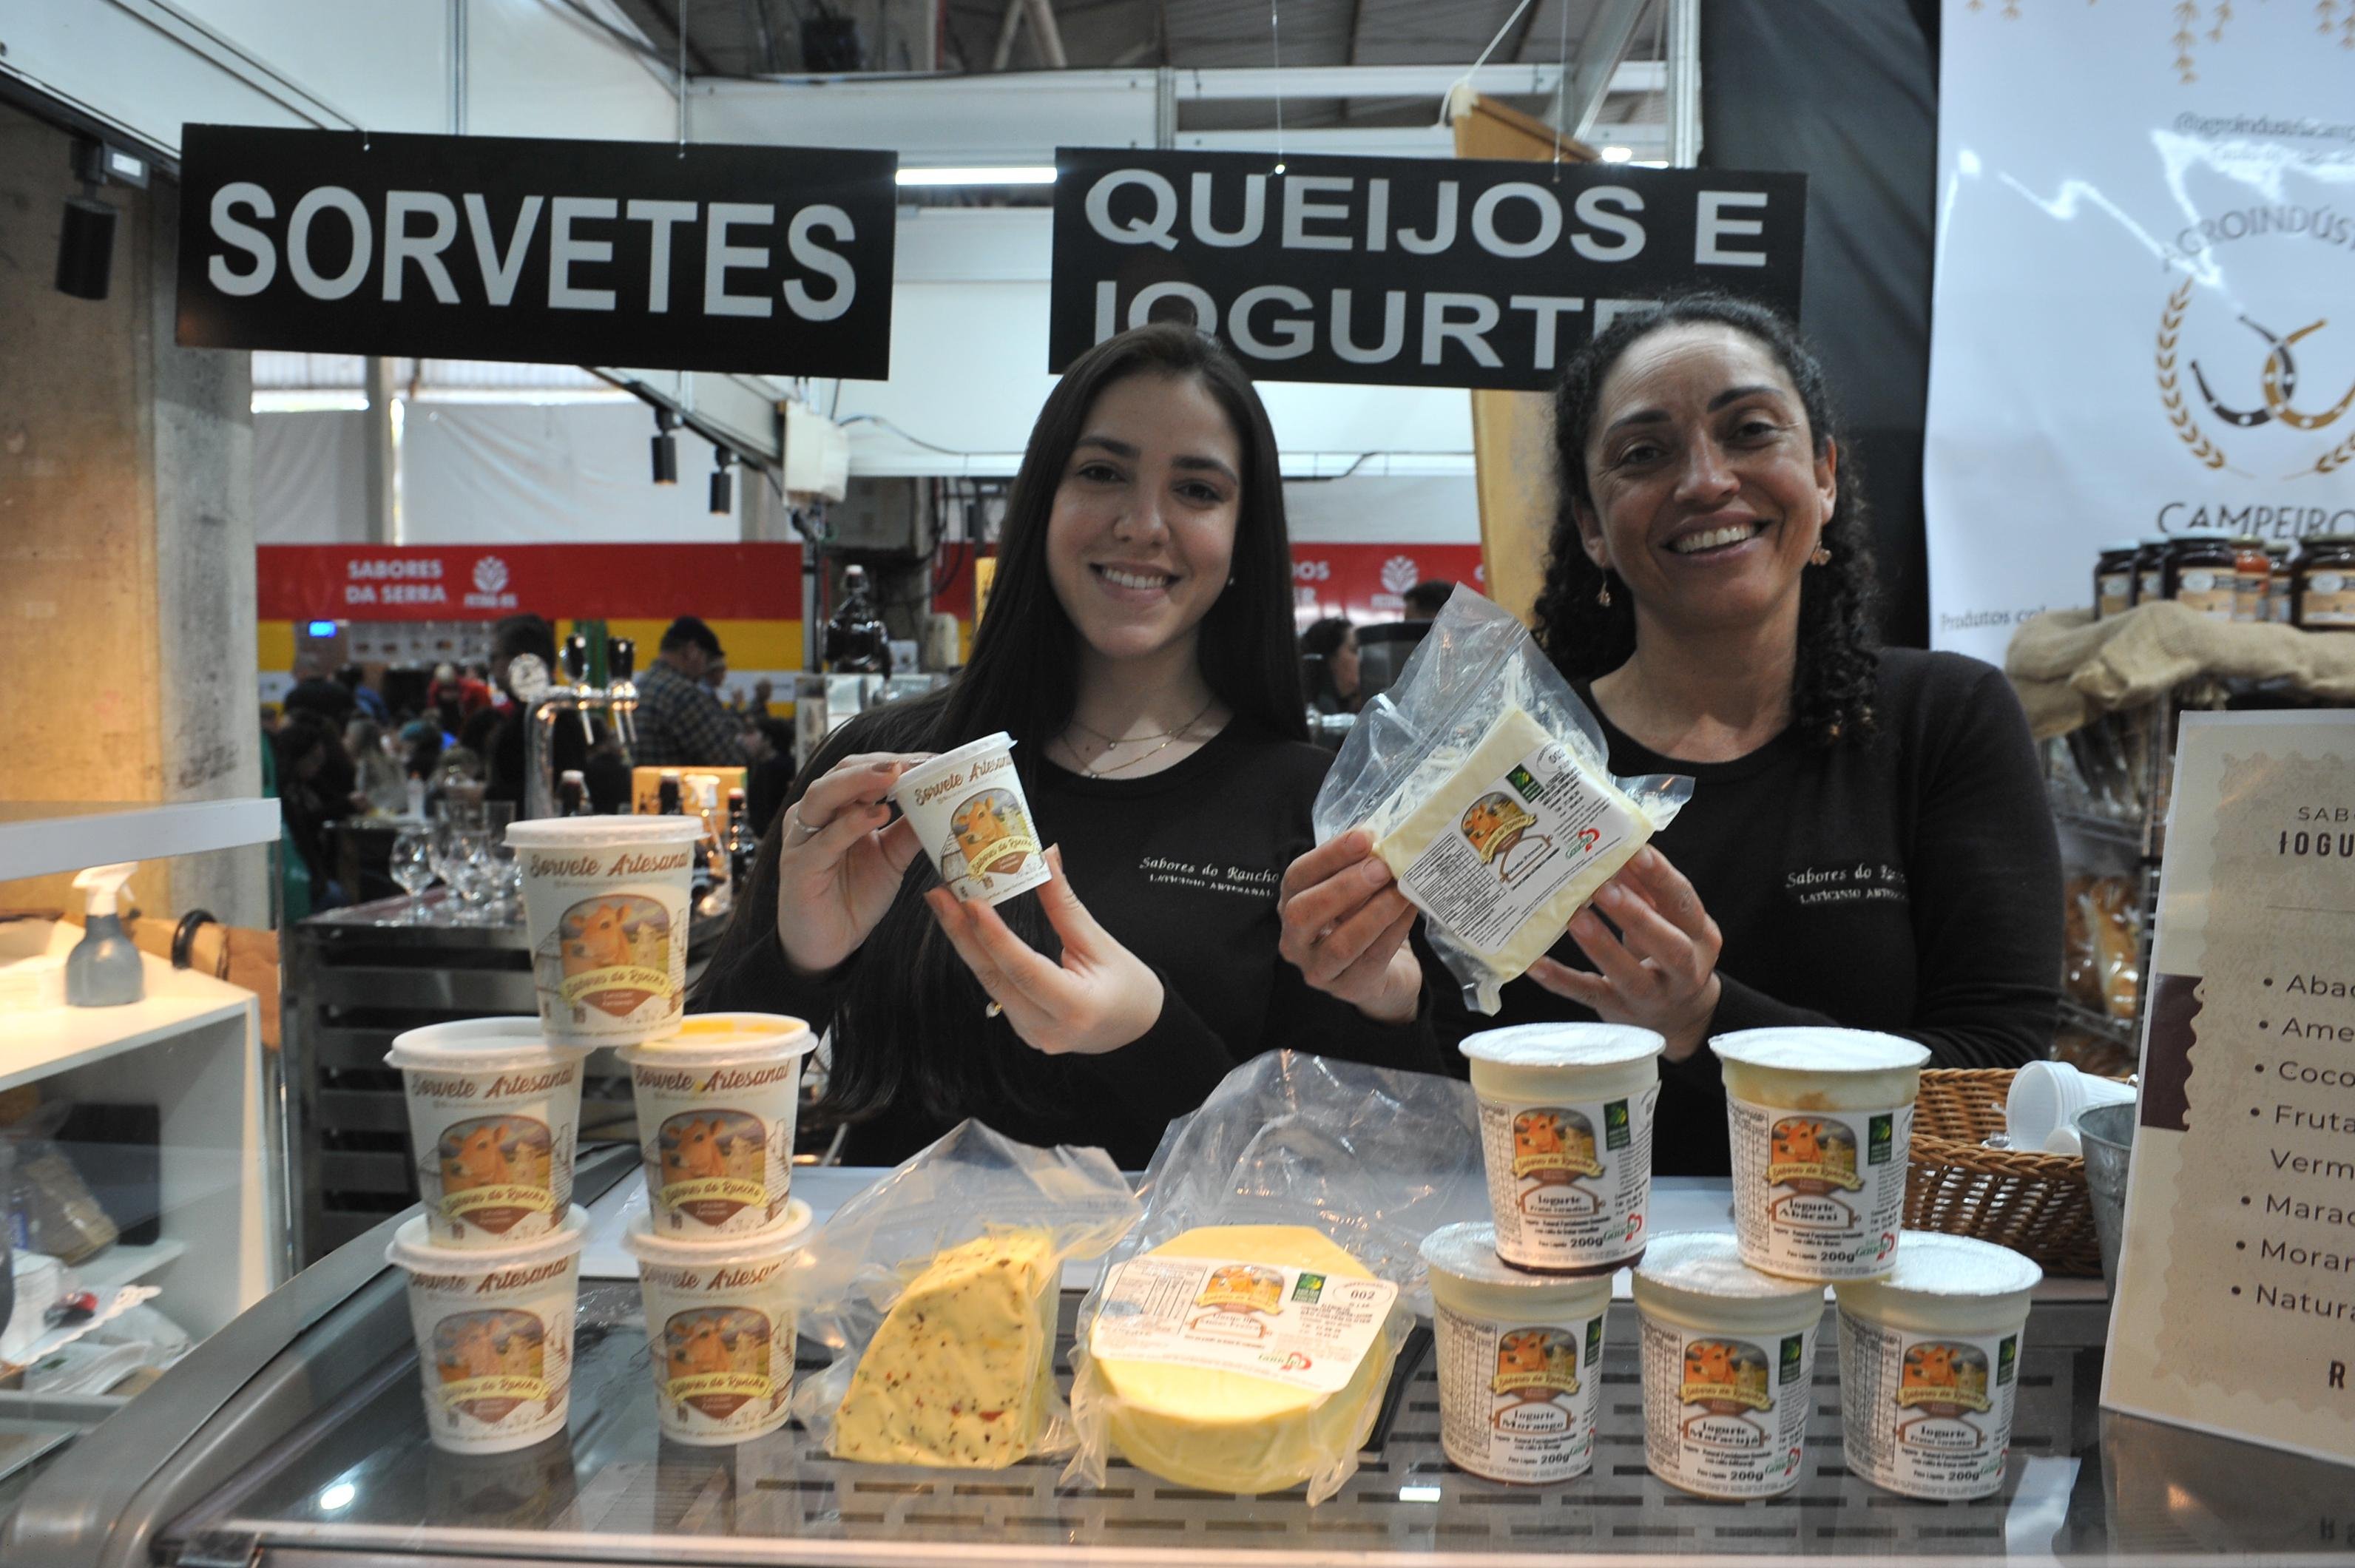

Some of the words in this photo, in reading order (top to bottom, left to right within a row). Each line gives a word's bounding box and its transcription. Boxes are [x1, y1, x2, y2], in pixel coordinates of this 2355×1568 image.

[1084, 169, 1647, 262] QUEIJOS
[1694, 190, 1768, 267] E
[2161, 203, 2355, 274] GROINDÚS
[208, 182, 856, 321] SORVETES
[1095, 280, 1664, 370] IOGURT
[348, 558, 443, 579] SABORES
[344, 584, 376, 604] DA
[380, 584, 447, 604] SERRA
[915, 772, 964, 806] Sorvete
[2297, 805, 2355, 822] SAB
[2279, 831, 2354, 857] IOGU
[530, 854, 602, 878] Sorvete
[1139, 856, 1195, 873] Sabores
[1202, 863, 1218, 877] do
[1227, 866, 1280, 883] Rancho
[1785, 868, 1847, 888] Sabores
[1854, 862, 1872, 879] do
[2282, 1017, 2355, 1042] Ame
[700, 1061, 791, 1093] Artesanal
[2279, 1061, 2355, 1087] Coco
[2276, 1105, 2355, 1133] Fruta
[2271, 1149, 2354, 1180] Verm
[1538, 1194, 1582, 1206] Iogurte
[1789, 1198, 1836, 1213] Iogurte
[1570, 1237, 1604, 1248] 200g
[1820, 1251, 1856, 1263] 200g
[1501, 1419, 1564, 1433] Morango
[1514, 1409, 1555, 1422] Iogurte
[1703, 1421, 1748, 1436] Iogurte
[1921, 1425, 1967, 1439] Iogurte
[1541, 1452, 1570, 1464] 200g
[1730, 1470, 1764, 1482] 200g
[1948, 1470, 1980, 1481] 200g
